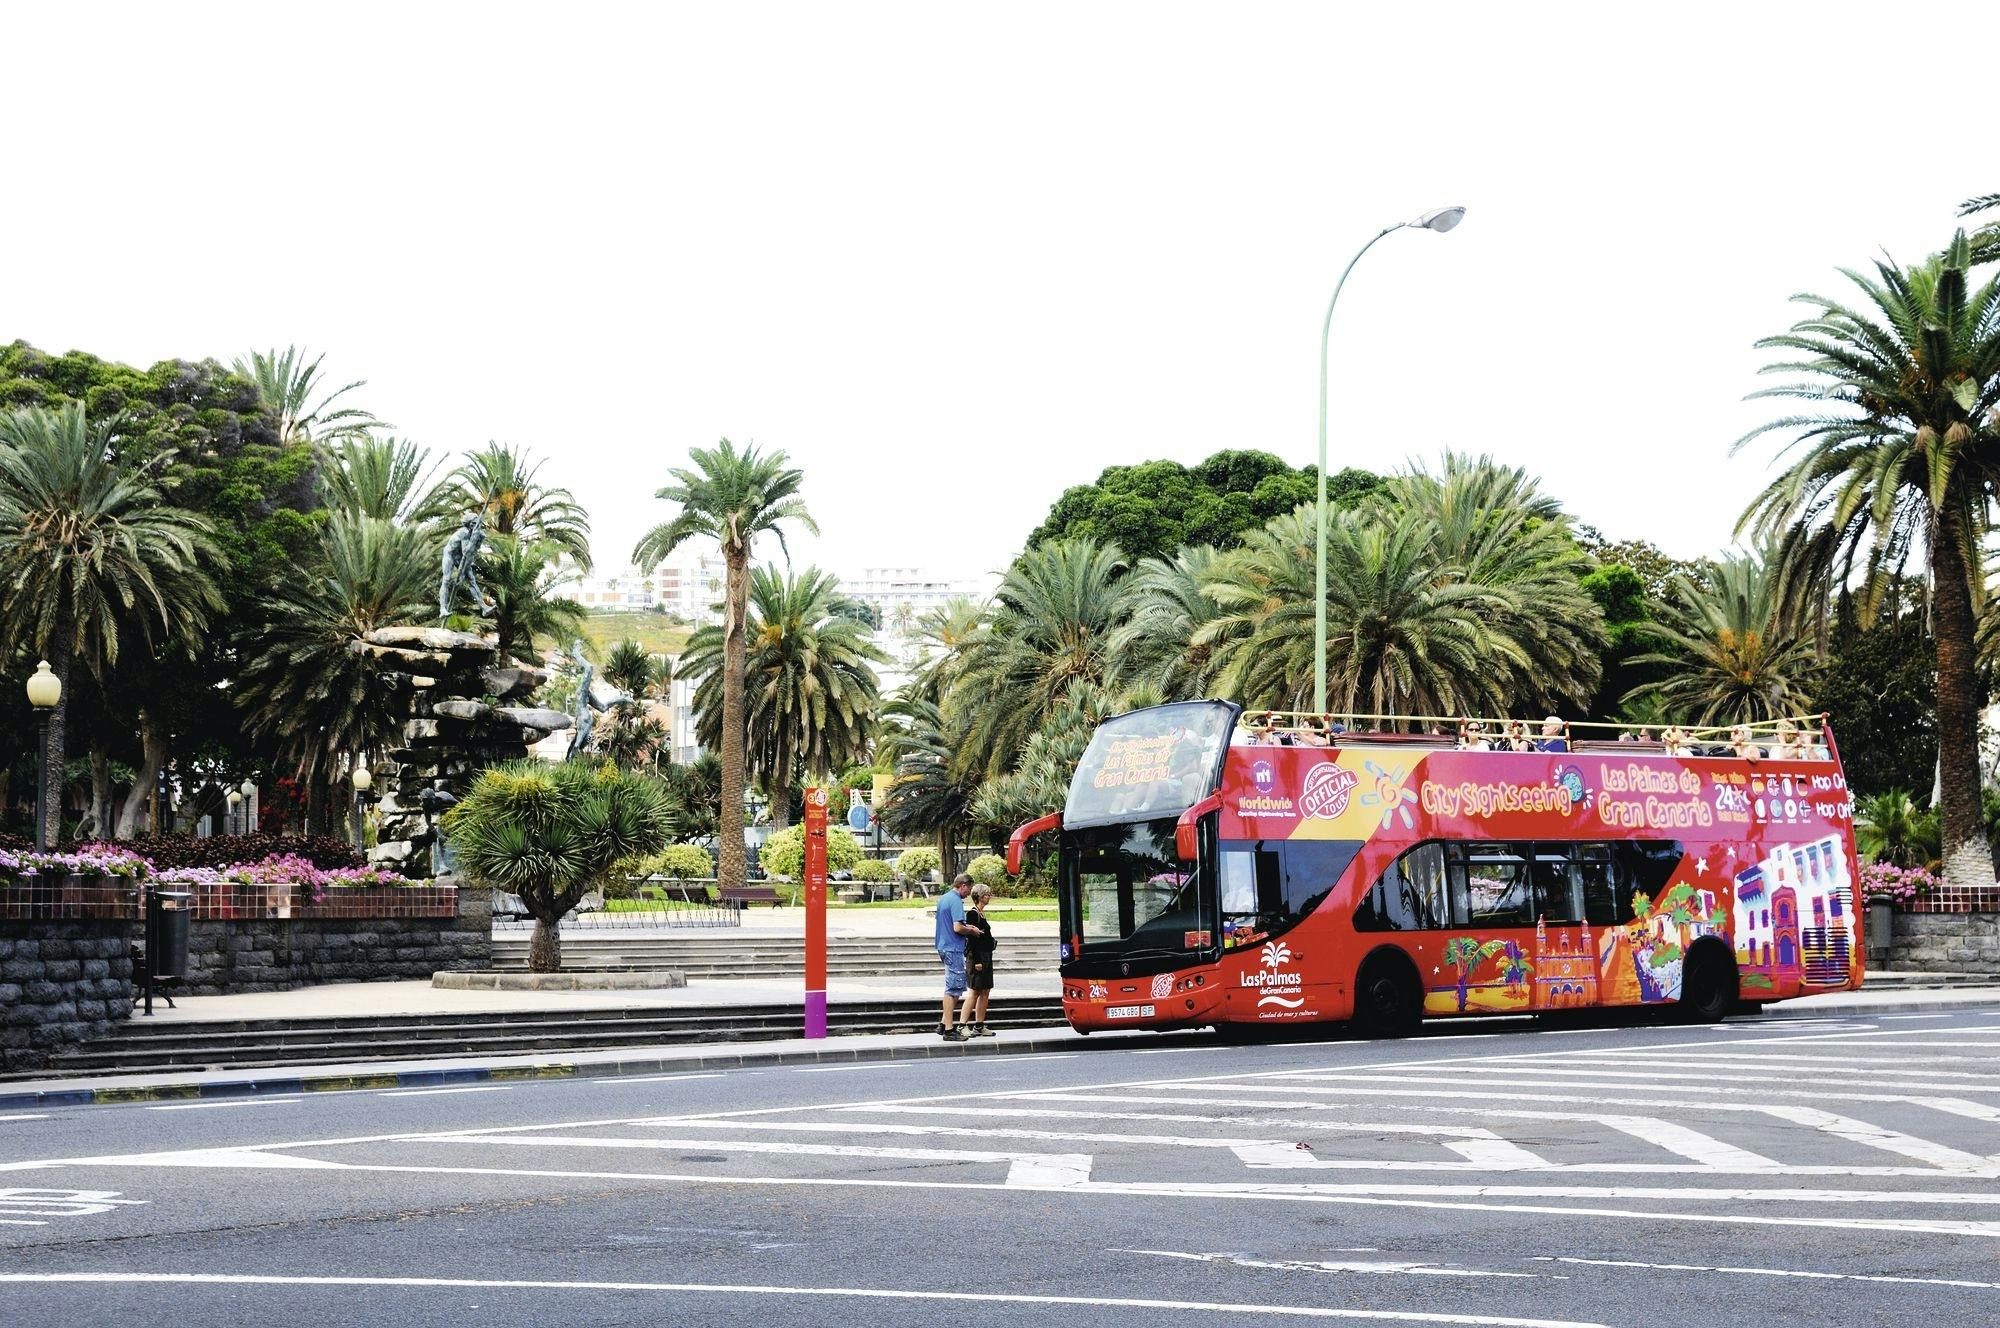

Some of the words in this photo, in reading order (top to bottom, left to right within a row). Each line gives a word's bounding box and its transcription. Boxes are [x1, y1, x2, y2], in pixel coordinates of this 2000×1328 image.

[1601, 763, 1628, 792] Las
[1628, 763, 1678, 793] Palmas
[1680, 768, 1701, 795] de
[1811, 774, 1831, 791] Hop
[1833, 772, 1846, 789] On
[1306, 772, 1356, 813] OFFICIAL
[1421, 780, 1460, 818] City
[1460, 781, 1571, 818] Sightseeing
[1715, 784, 1733, 810] 24
[1325, 795, 1347, 815] TOUR
[1598, 791, 1645, 827] Gran
[1646, 795, 1713, 829] Canaria
[1816, 801, 1836, 819] Hop
[1837, 802, 1851, 819] Off
[1110, 1007, 1126, 1018] 9574
[1142, 1005, 1154, 1016] SP
